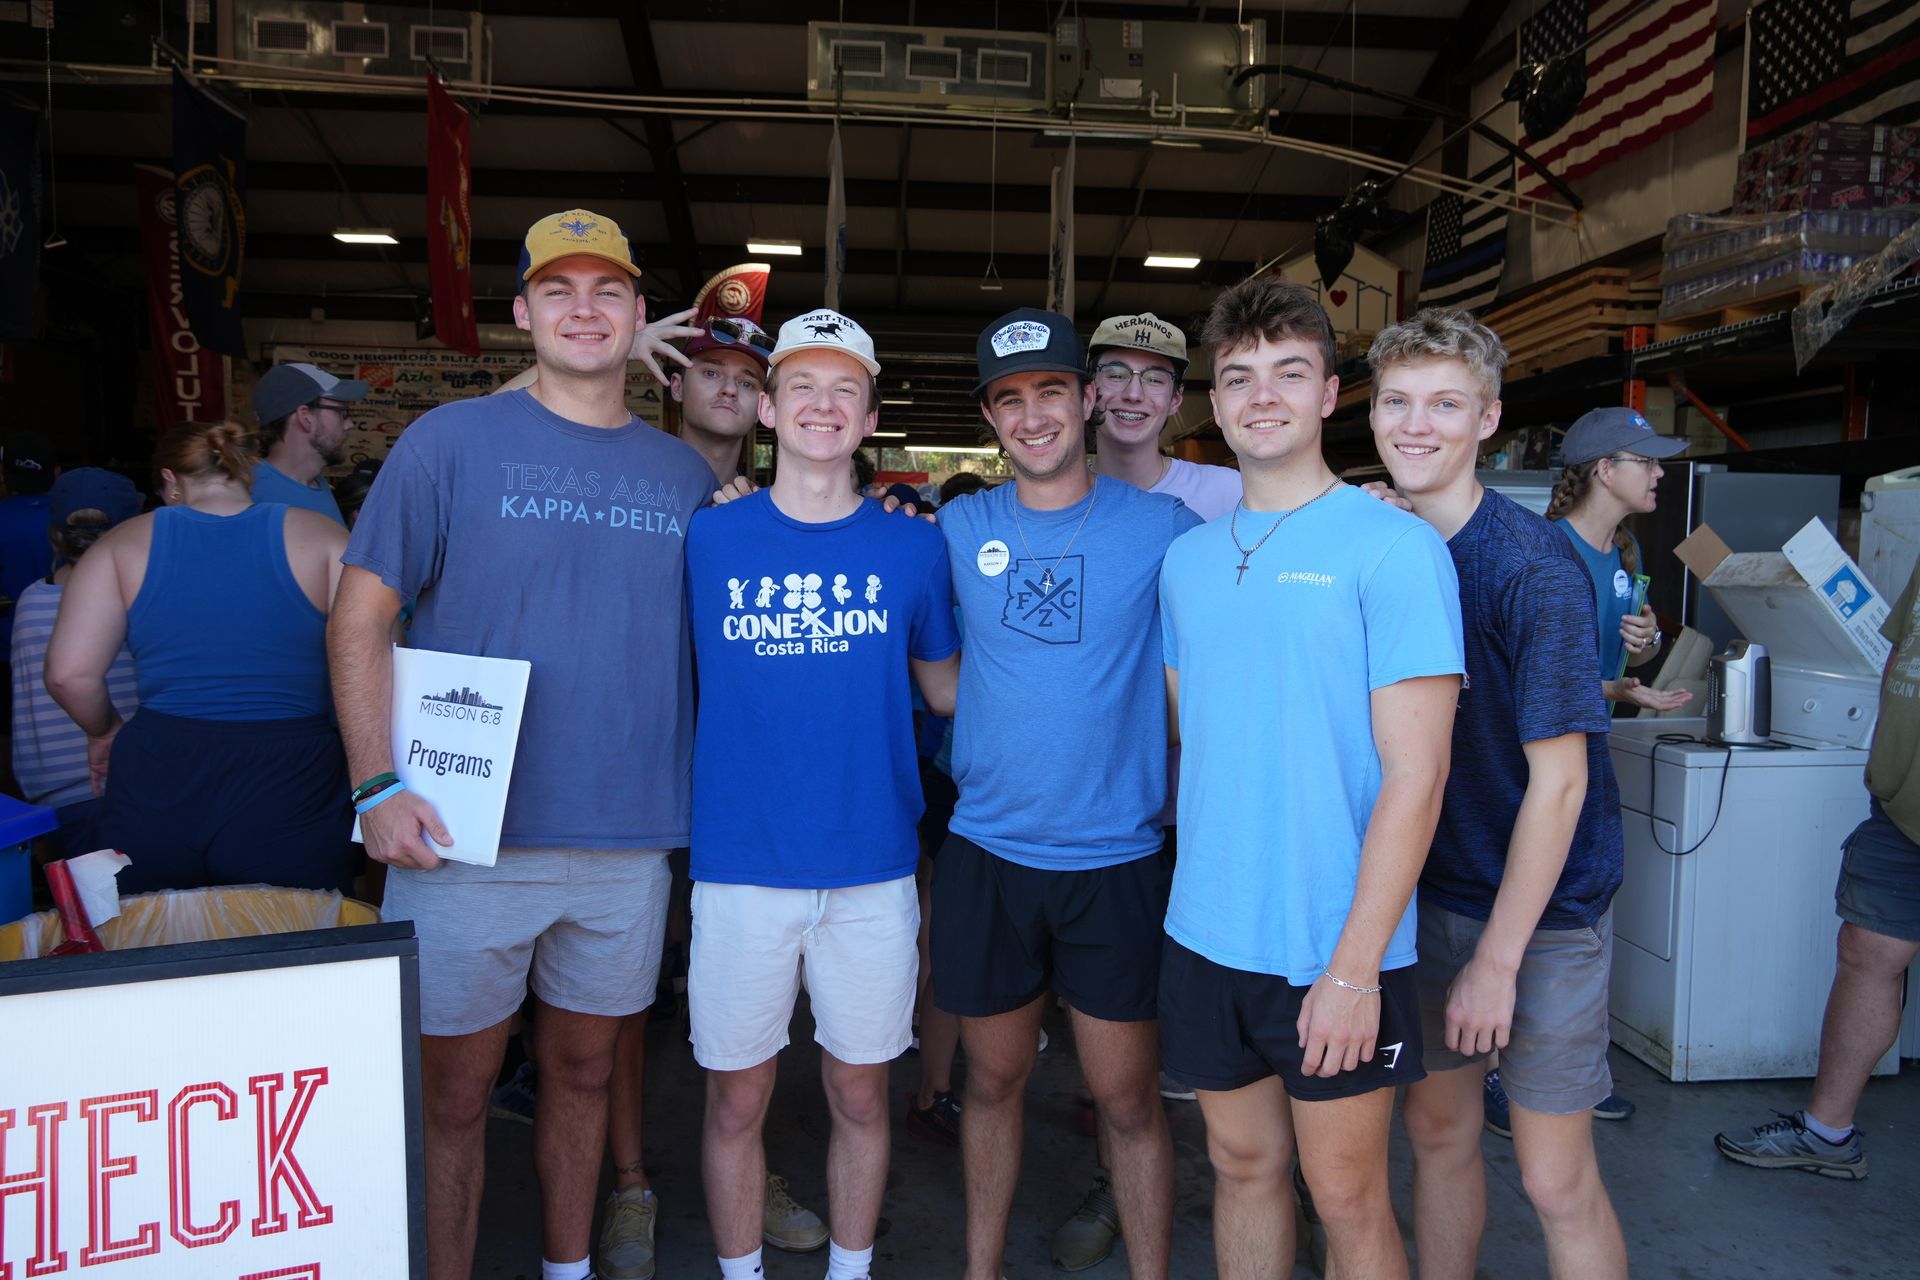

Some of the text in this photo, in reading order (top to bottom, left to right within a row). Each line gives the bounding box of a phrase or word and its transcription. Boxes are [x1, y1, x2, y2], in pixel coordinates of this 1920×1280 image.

[1115, 317, 1173, 339] HERMANOS
[308, 350, 350, 360] GOOD
[354, 353, 437, 362] NEIGHBORS
[441, 355, 480, 363] BLITZ
[395, 371, 433, 383] Azle
[501, 462, 681, 512] TEXAS A&M
[501, 495, 683, 537] KAPPA DELTA
[1289, 572, 1333, 584] MAGELLAN
[1016, 592, 1033, 610] F
[1060, 590, 1077, 609] C
[723, 607, 888, 641] CONEXION
[1038, 609, 1053, 627] Z
[754, 638, 849, 656] Costa Rica
[419, 702, 502, 726] MISSION 6:8
[407, 739, 493, 779] Programs
[0, 1066, 334, 1280] HECK
